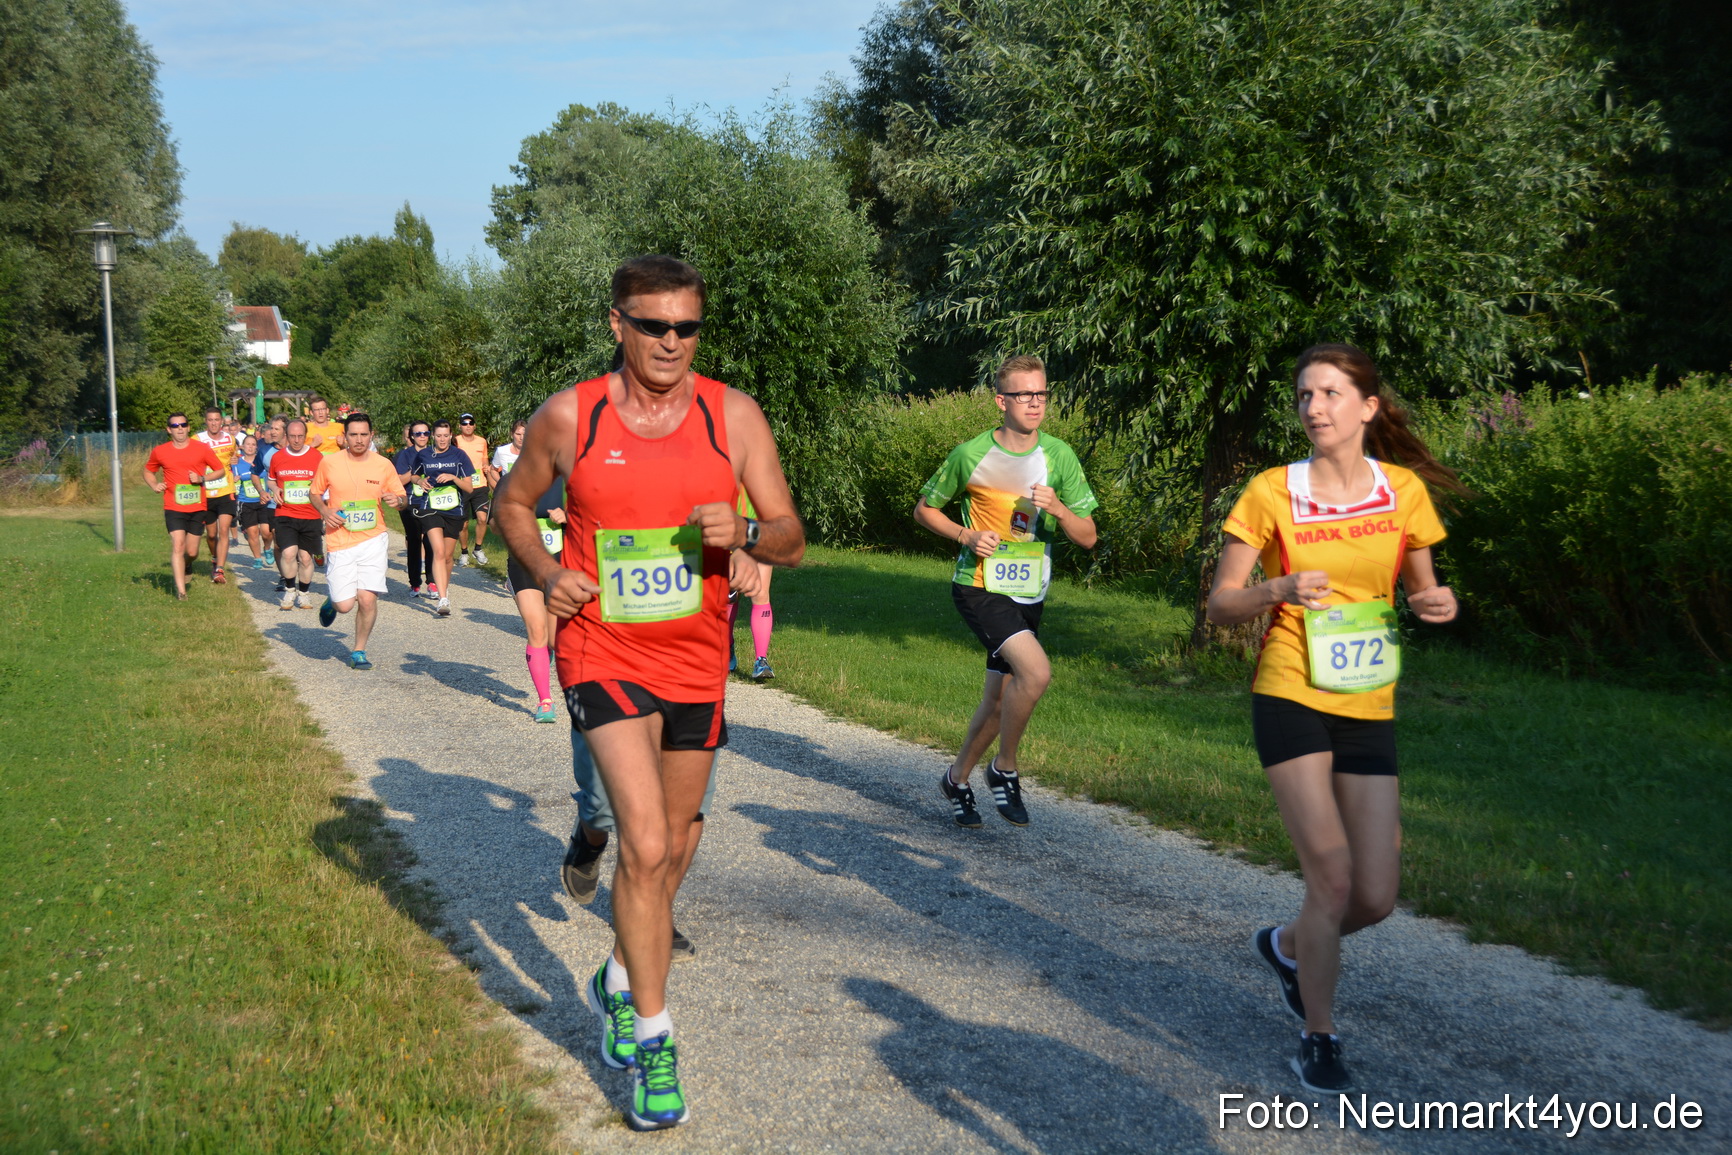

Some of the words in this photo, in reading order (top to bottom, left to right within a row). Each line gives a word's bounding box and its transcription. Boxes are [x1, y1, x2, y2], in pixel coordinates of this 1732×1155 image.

[178, 491, 199, 500] 1491
[287, 489, 310, 498] 1404
[435, 495, 453, 505] 376
[346, 511, 374, 523] 1542
[1294, 528, 1343, 545] MAX
[1348, 519, 1399, 538] BÖGL
[995, 562, 1031, 581] 985
[610, 563, 693, 597] 1390
[1330, 637, 1384, 670] 872
